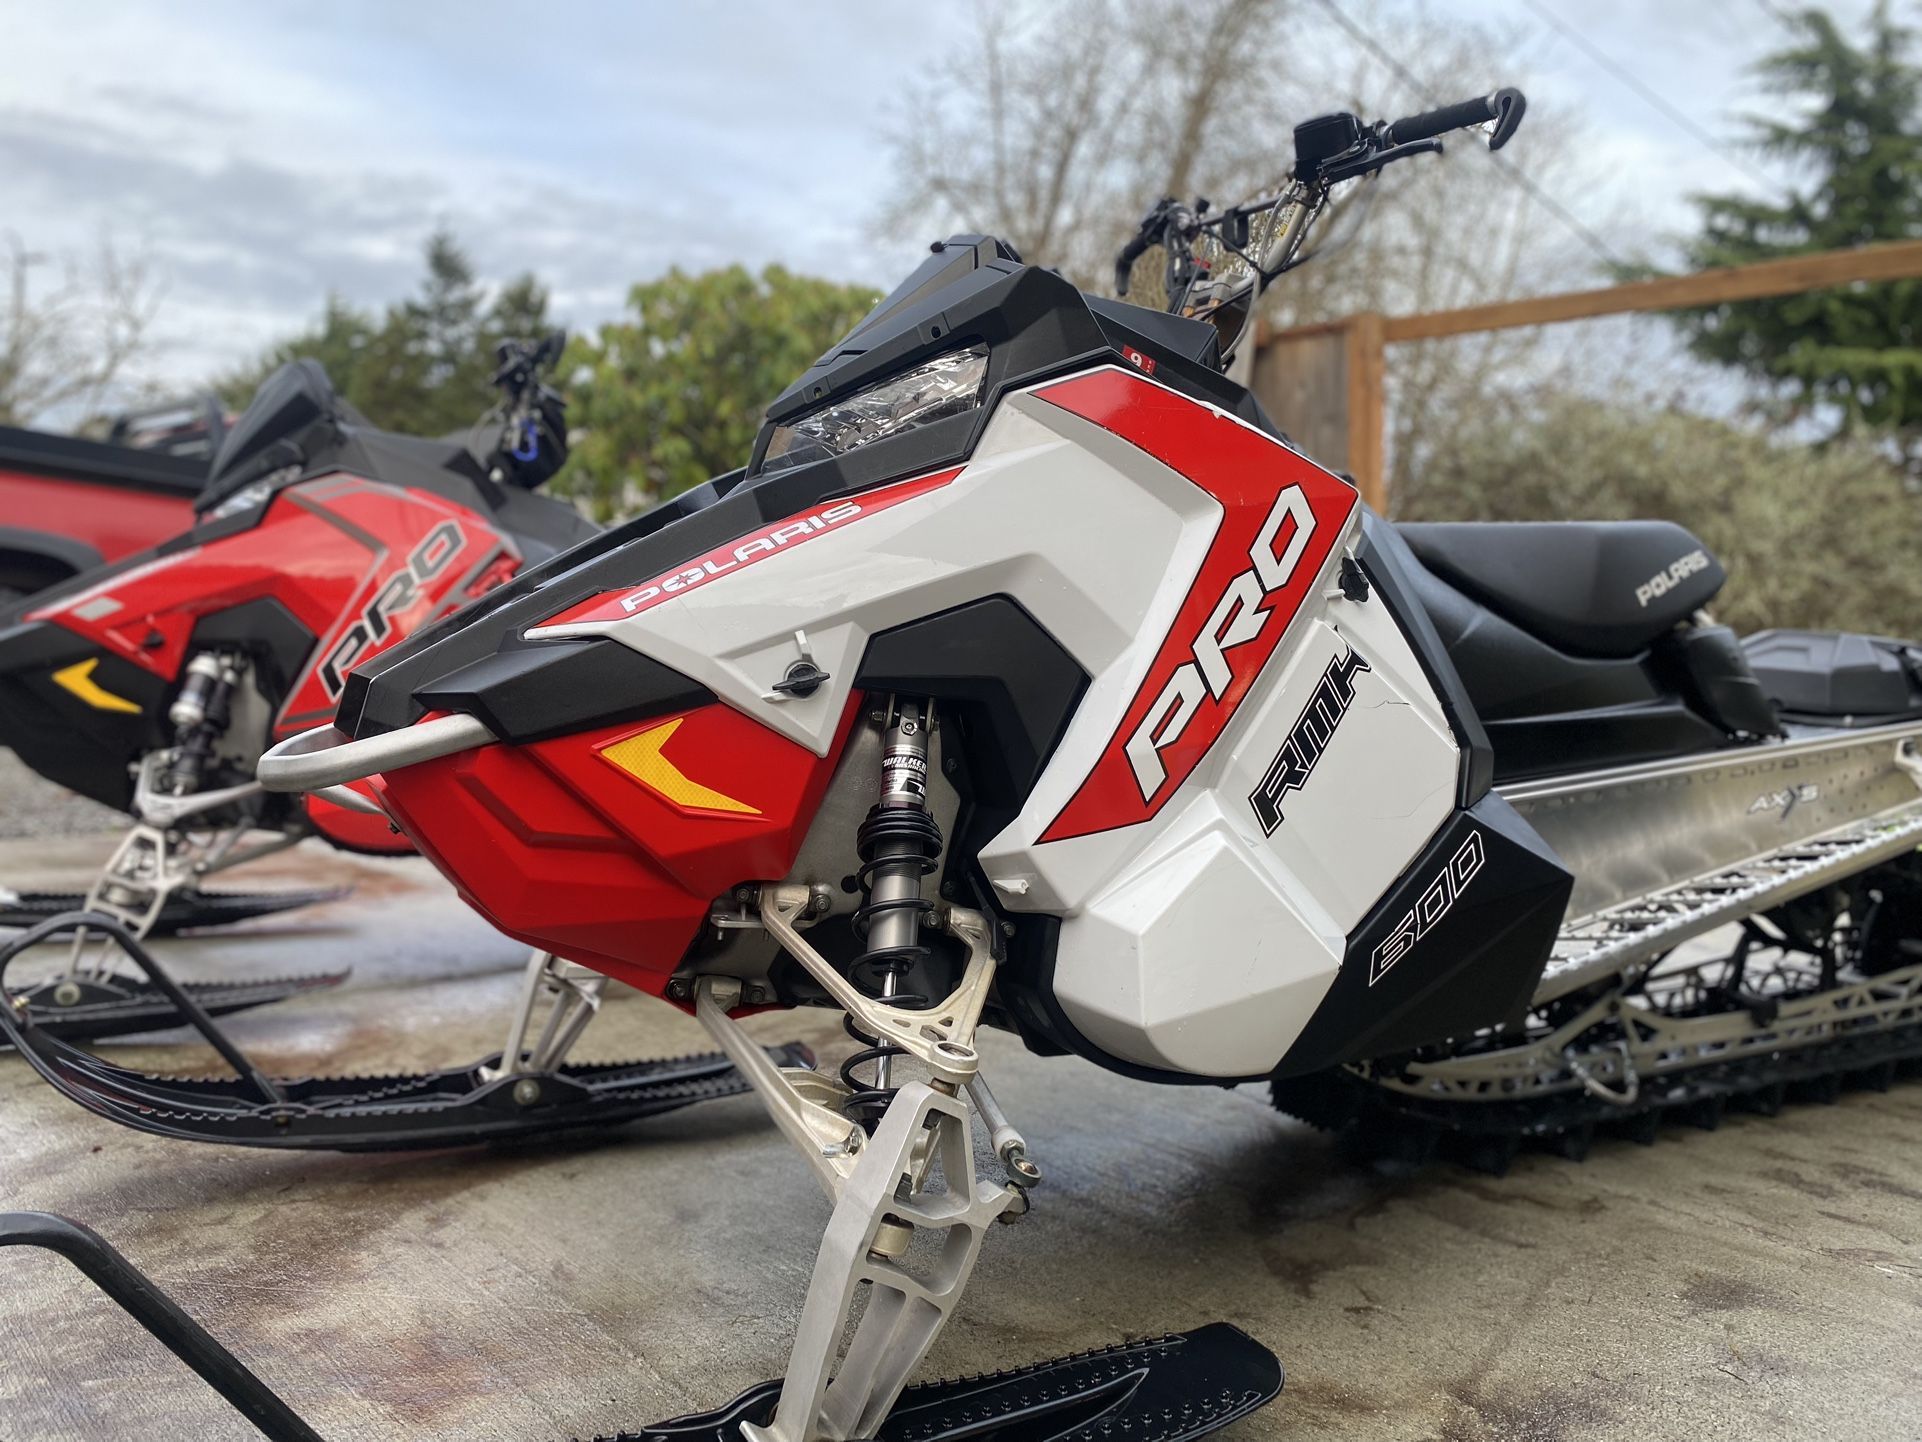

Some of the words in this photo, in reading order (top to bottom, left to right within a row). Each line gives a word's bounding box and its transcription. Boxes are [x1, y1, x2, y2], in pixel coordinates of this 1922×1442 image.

[317, 518, 467, 703] PRO
[620, 501, 863, 612] POLARIS
[1635, 549, 1710, 607] POLARIS
[1123, 482, 1318, 806] PRO
[1248, 627, 1371, 838] RMK
[1368, 829, 1486, 988] 600
